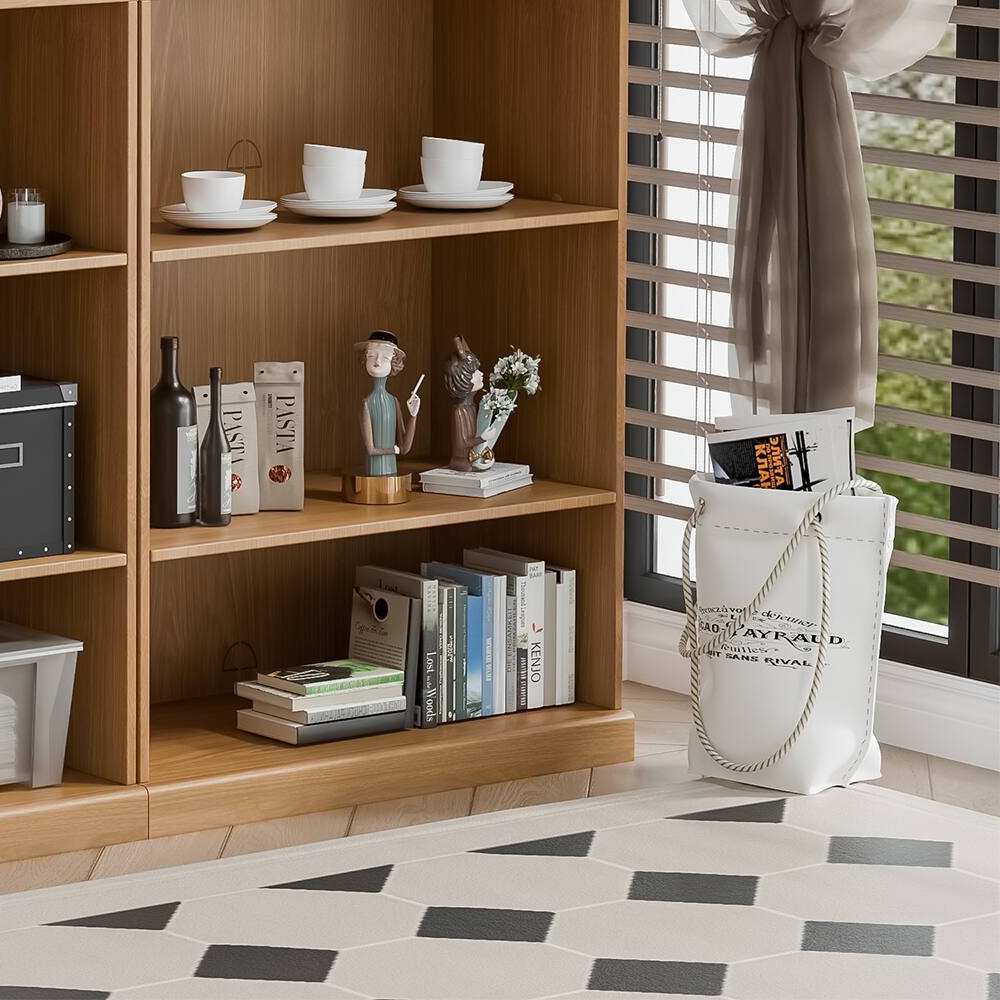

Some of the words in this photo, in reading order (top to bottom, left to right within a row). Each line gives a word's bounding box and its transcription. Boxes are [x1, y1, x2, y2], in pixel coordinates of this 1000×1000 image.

[223, 409, 245, 465] PASTA
[276, 396, 295, 453] PASTA
[768, 436, 785, 486] ЭЛИТА
[426, 651, 437, 673] Lost
[530, 642, 542, 684] KENJO
[725, 653, 759, 662] SANS
[765, 657, 813, 668] RIVAL
[425, 688, 437, 722] Woods
